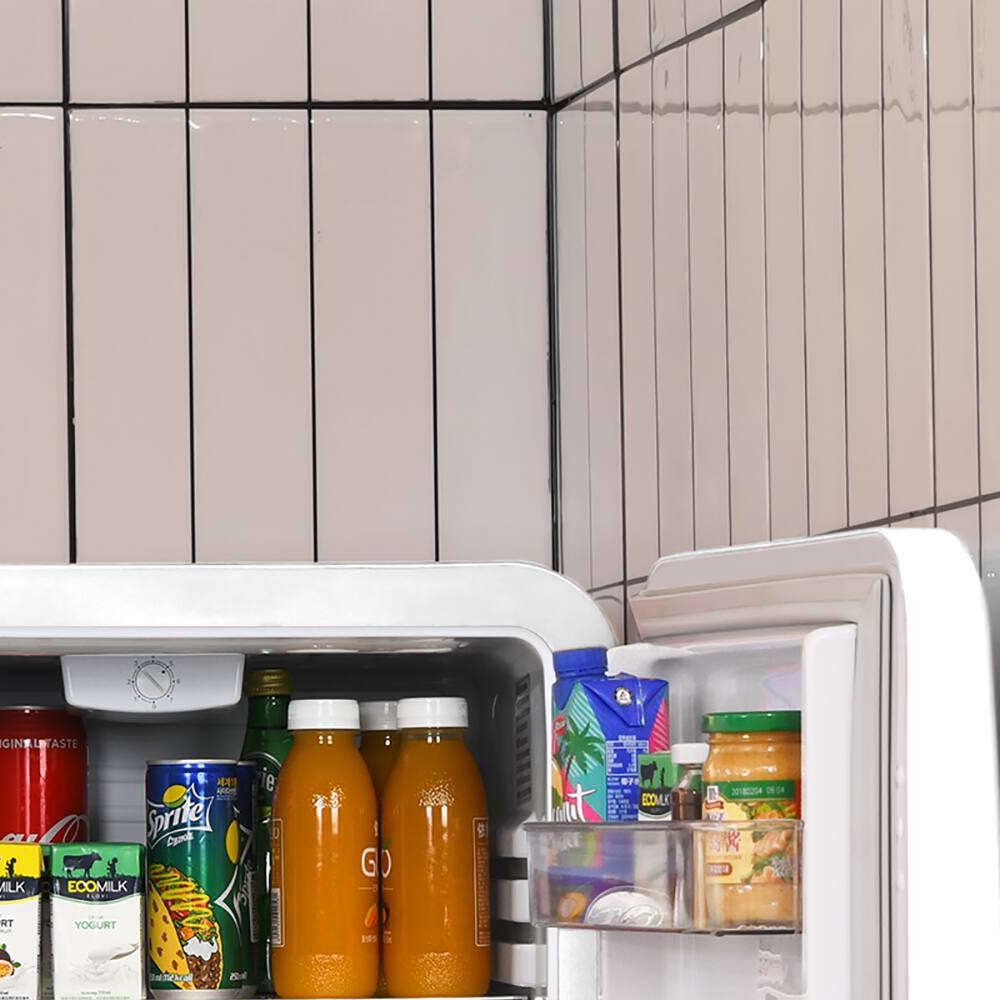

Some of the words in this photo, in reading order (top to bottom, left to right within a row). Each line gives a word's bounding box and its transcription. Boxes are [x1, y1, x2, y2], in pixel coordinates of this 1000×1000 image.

[45, 738, 79, 749] TASTE
[147, 796, 205, 840] Sprite
[67, 880, 128, 892] ECOMILK
[74, 920, 117, 930] YOGURT
